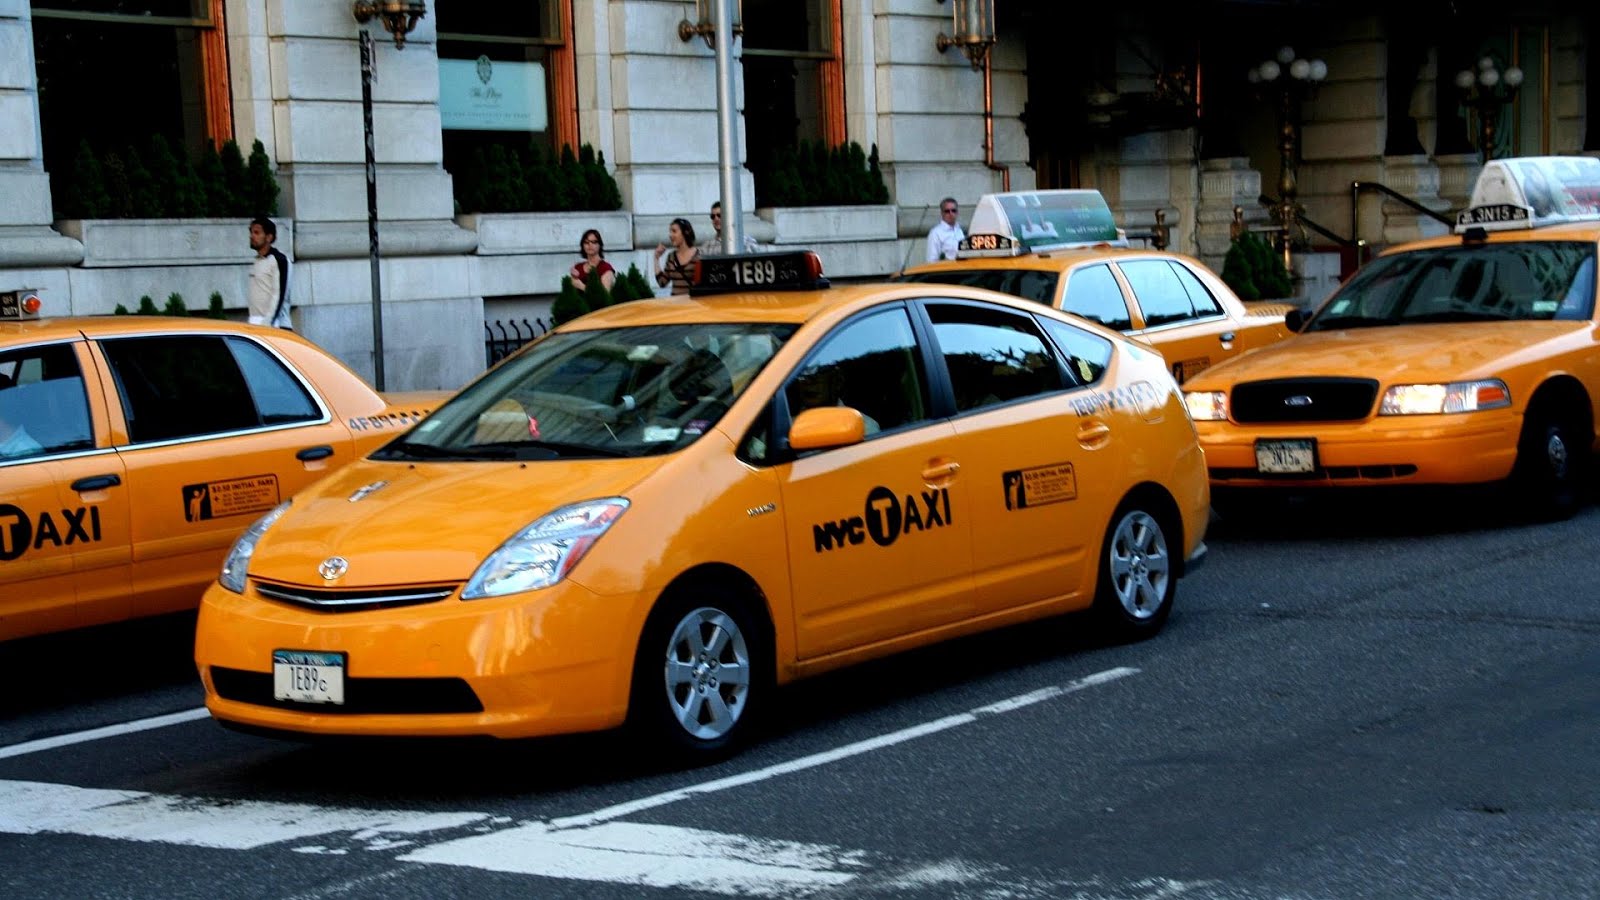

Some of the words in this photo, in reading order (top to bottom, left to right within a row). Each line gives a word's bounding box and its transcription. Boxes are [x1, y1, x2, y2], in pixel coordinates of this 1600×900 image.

[1476, 205, 1510, 223] 3N15
[732, 260, 776, 285] 1E89
[349, 415, 394, 432] 4F89
[0, 506, 101, 559] TAXI
[812, 516, 865, 553] NYC
[866, 487, 952, 545] TAXI
